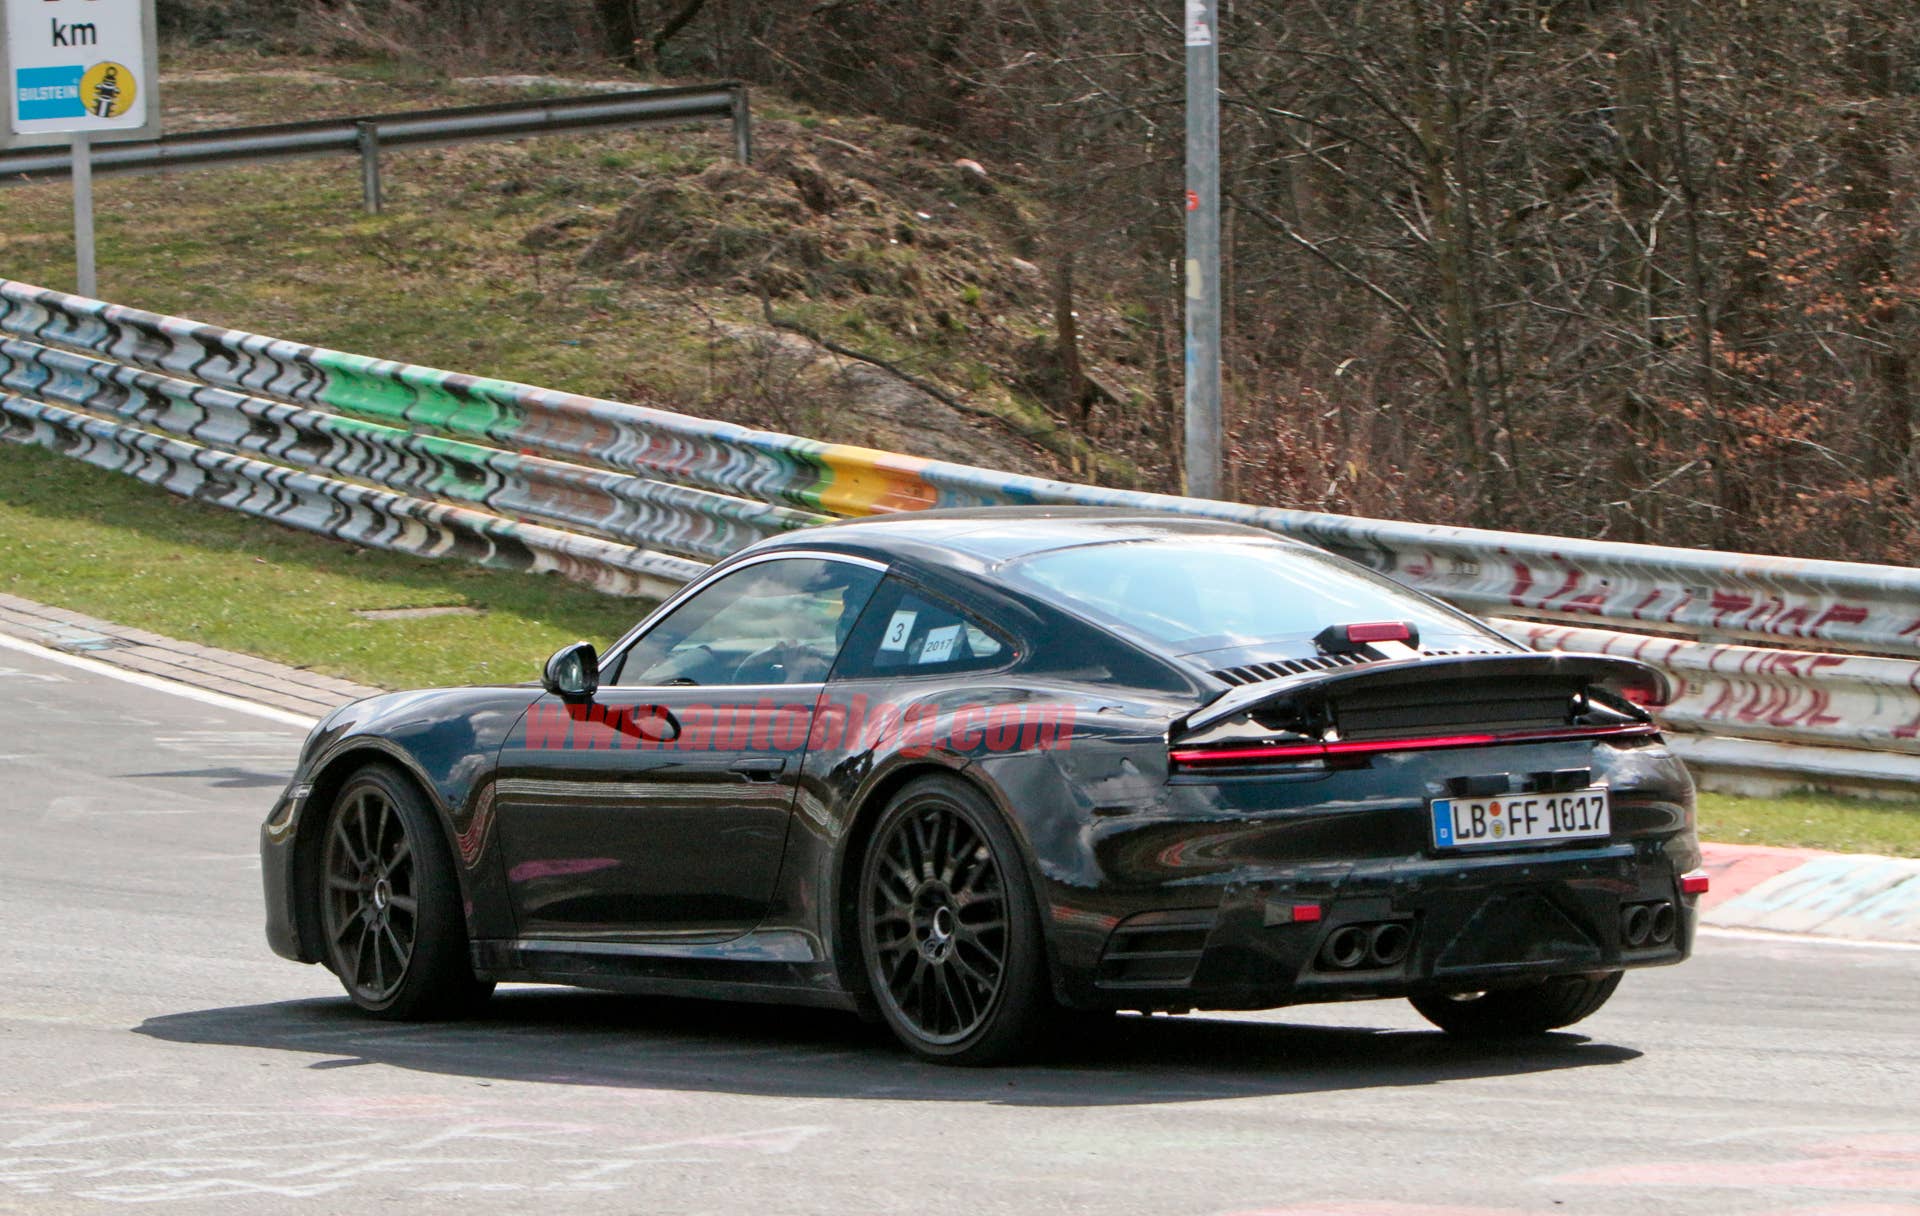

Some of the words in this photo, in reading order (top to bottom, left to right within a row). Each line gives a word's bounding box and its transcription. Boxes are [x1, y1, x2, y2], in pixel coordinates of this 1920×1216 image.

[52, 17, 97, 47] km
[19, 85, 79, 101] BILSTEIN
[892, 623, 905, 642] 3
[926, 639, 953, 652] 2017
[1453, 804, 1486, 839] LB
[1508, 801, 1538, 835] FF
[1546, 796, 1603, 832] 1017
